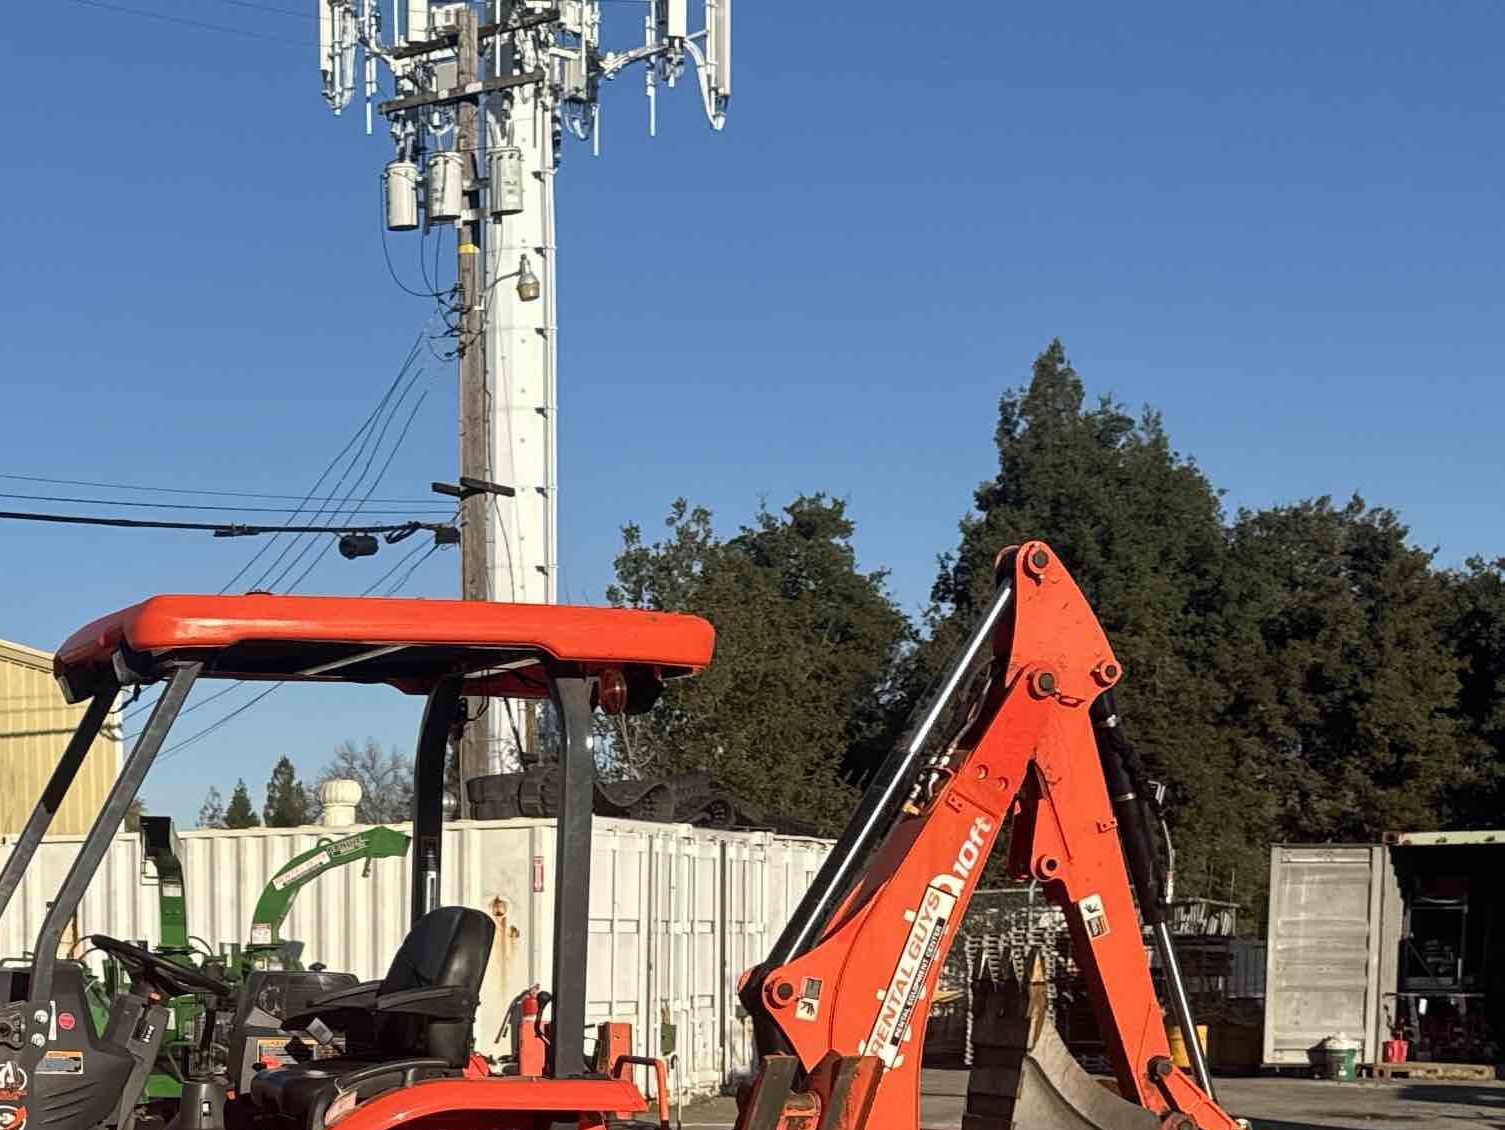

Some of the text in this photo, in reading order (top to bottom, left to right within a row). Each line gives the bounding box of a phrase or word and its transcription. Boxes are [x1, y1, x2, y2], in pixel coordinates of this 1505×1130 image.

[953, 815, 993, 879] 10ft
[868, 890, 942, 1057] RENTAL GUYS
